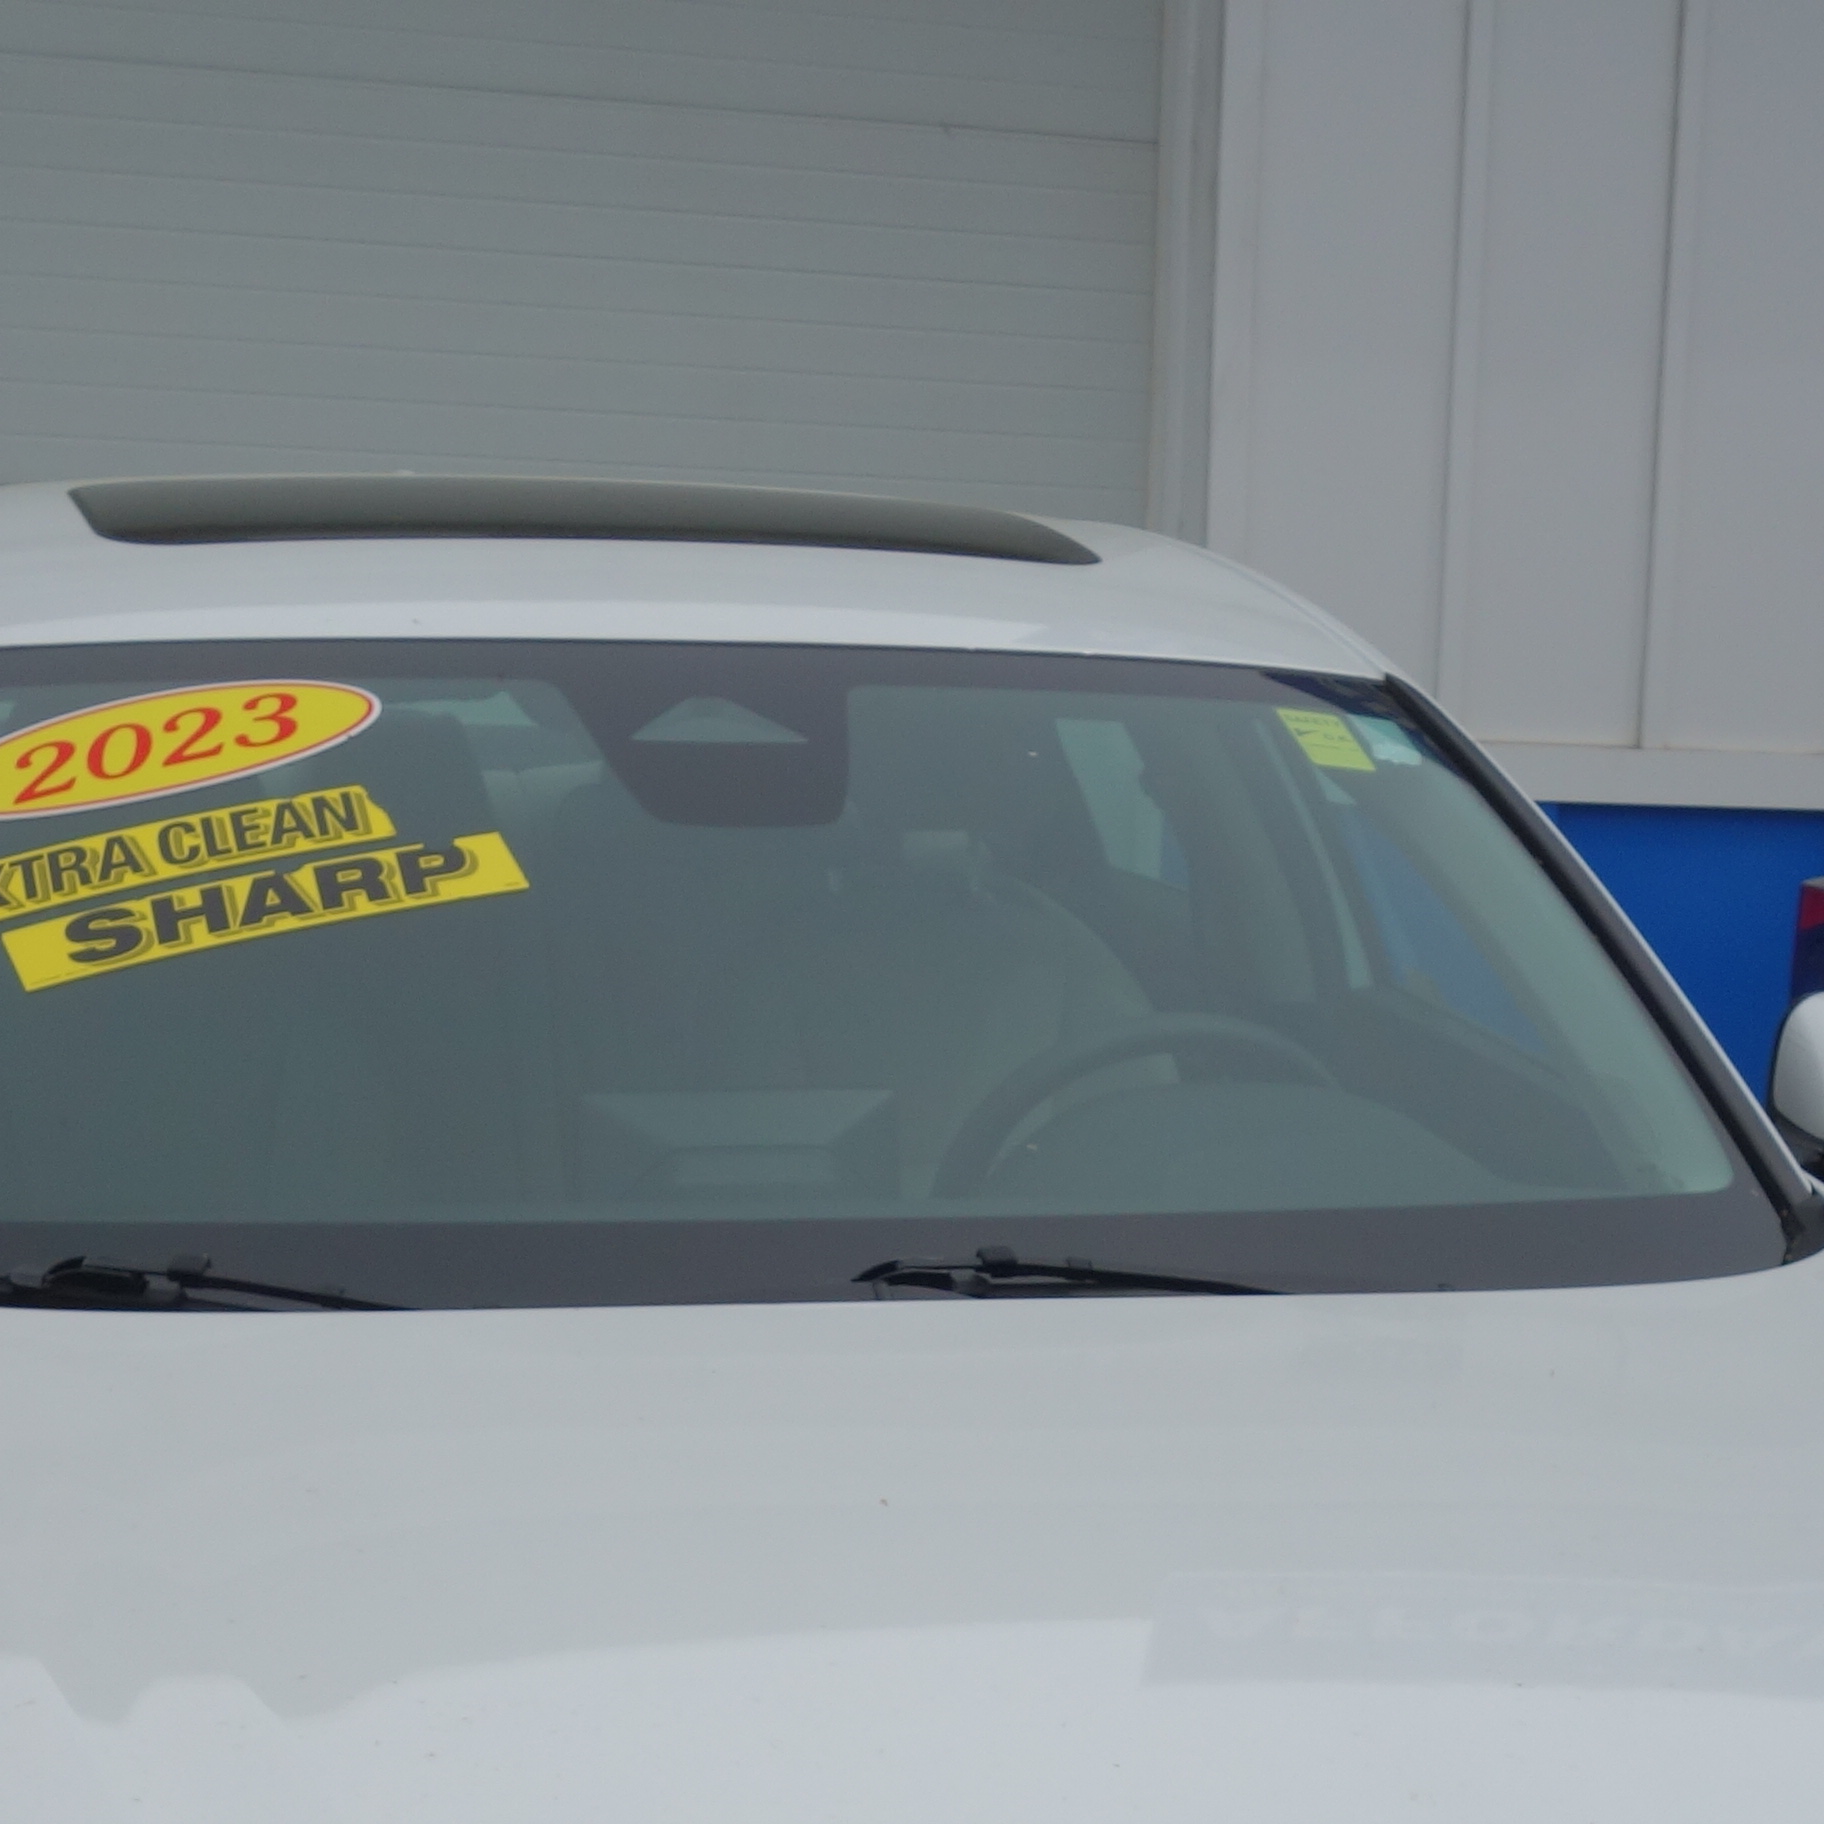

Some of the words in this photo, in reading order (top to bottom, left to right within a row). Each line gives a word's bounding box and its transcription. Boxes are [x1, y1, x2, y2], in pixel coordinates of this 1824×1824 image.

[14, 692, 299, 805] 2023
[157, 790, 373, 869] CLEAN
[65, 842, 476, 965] SHARP
